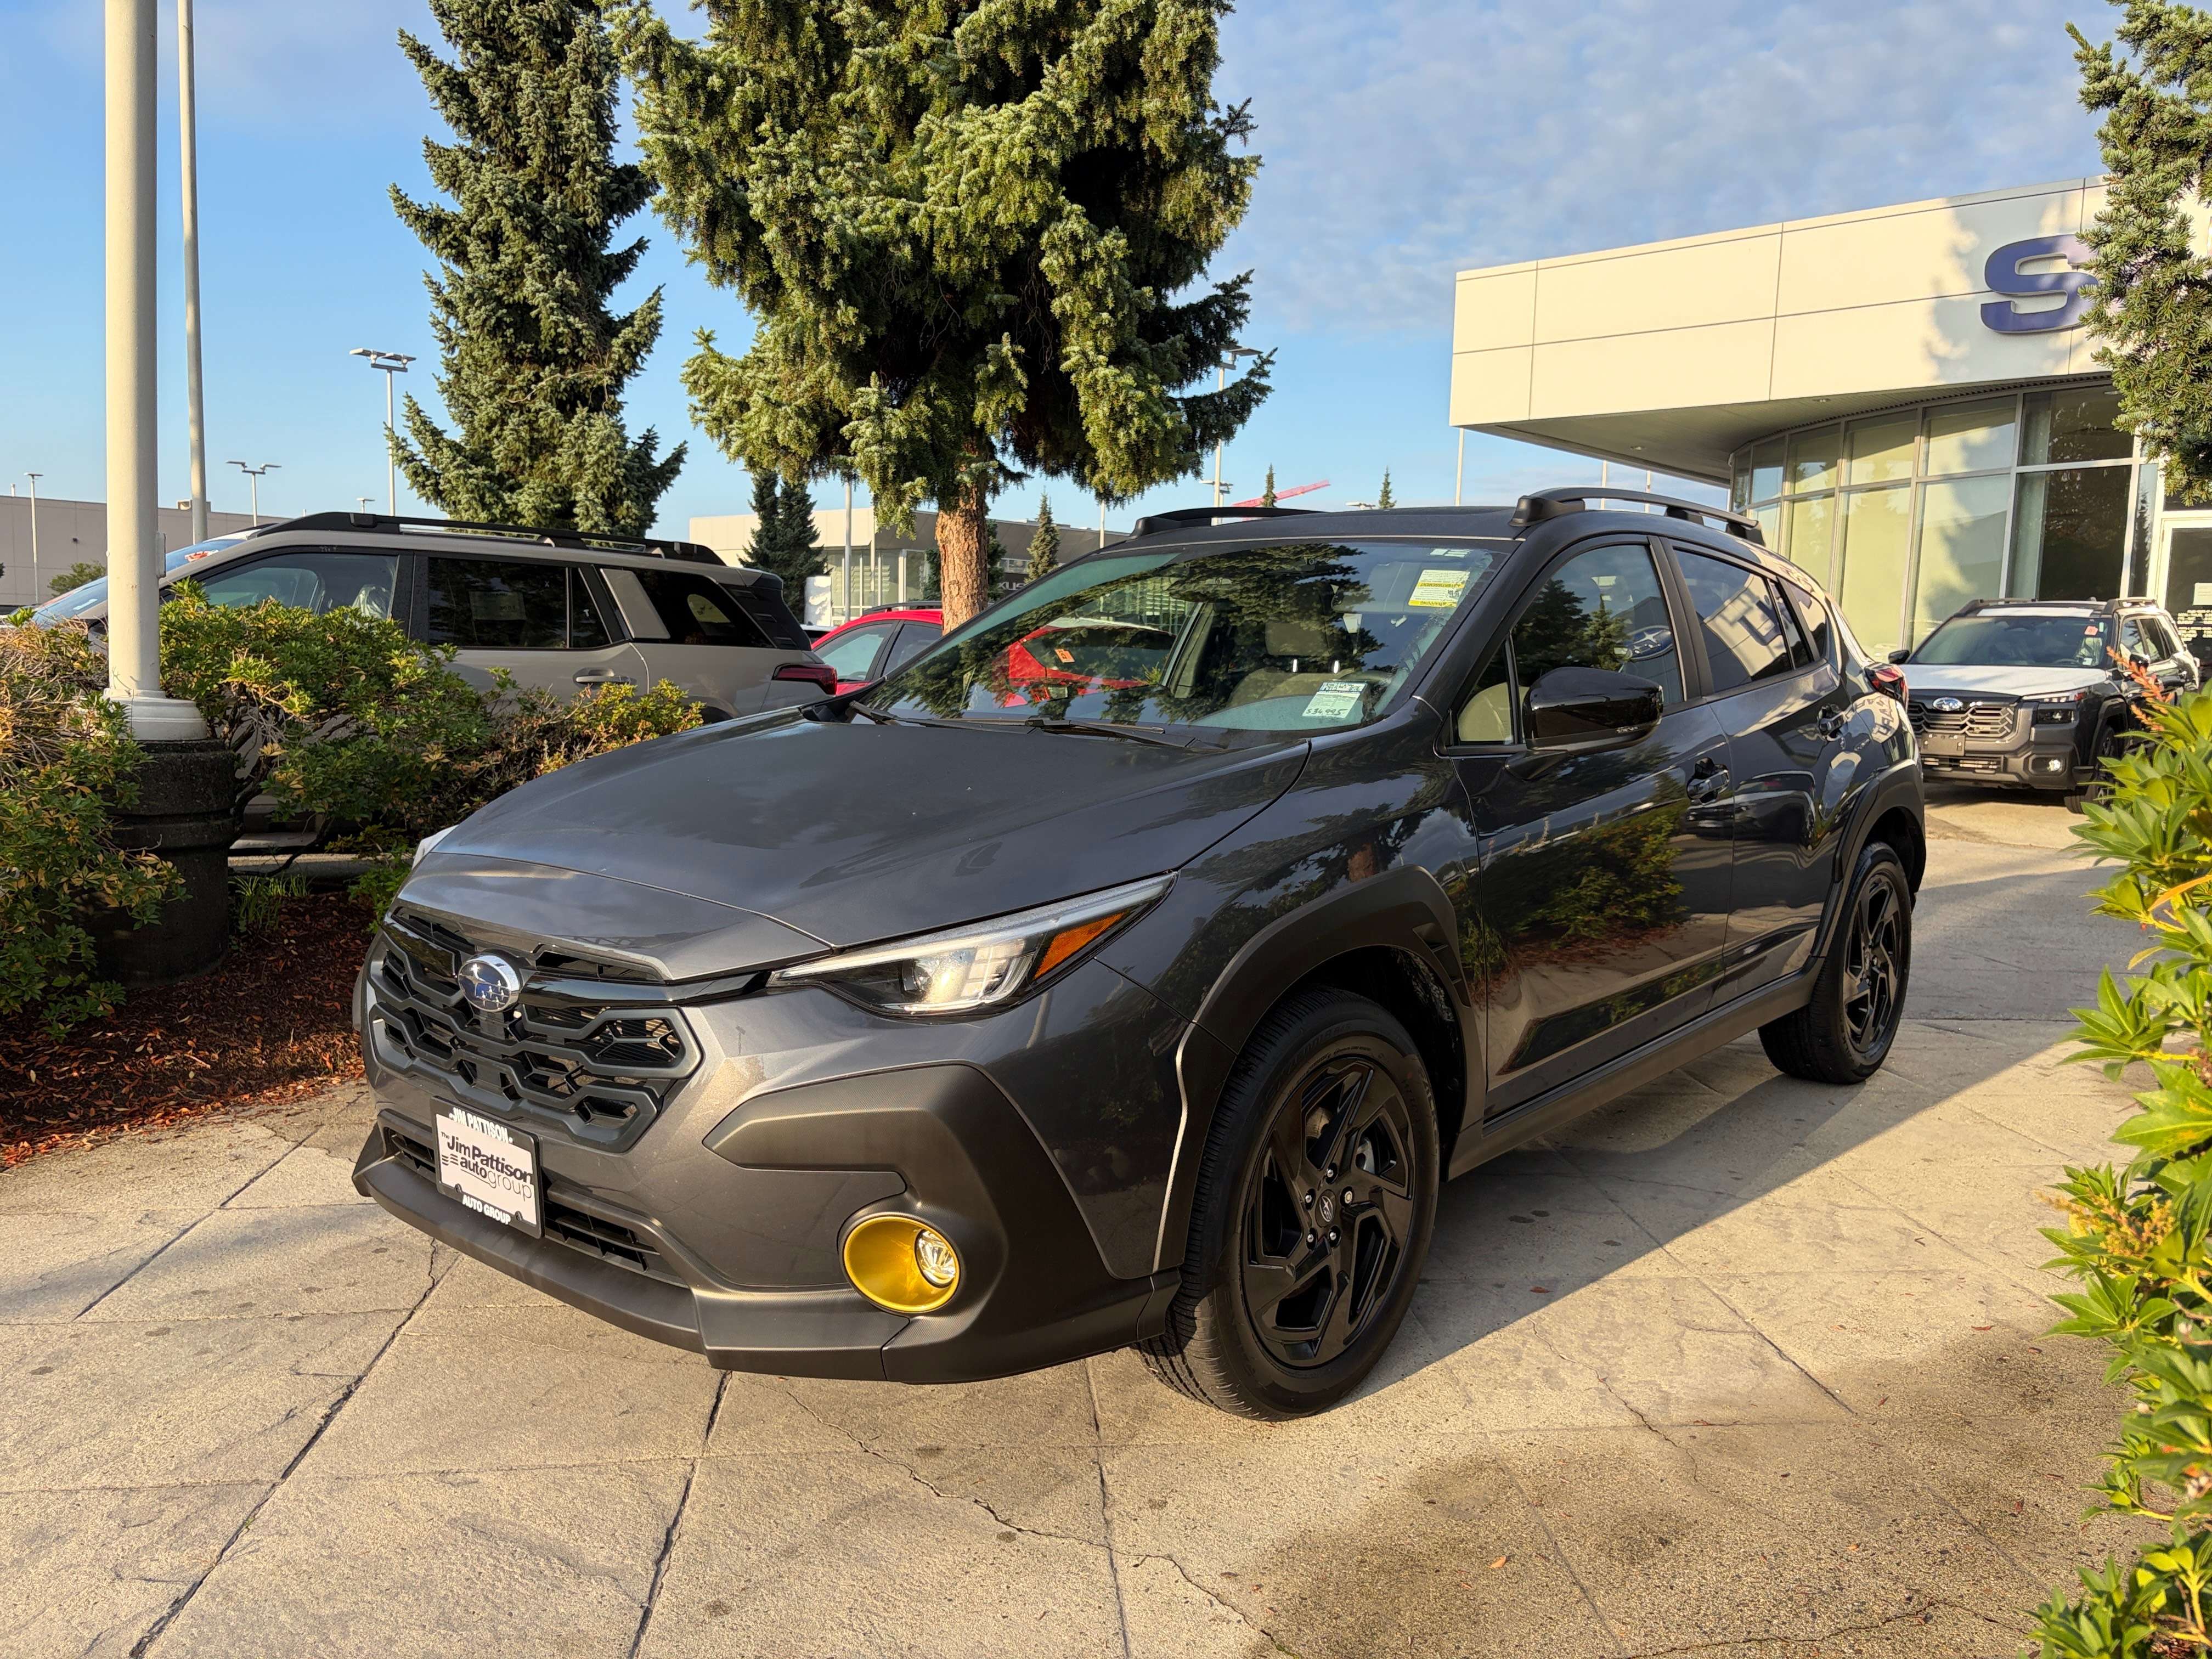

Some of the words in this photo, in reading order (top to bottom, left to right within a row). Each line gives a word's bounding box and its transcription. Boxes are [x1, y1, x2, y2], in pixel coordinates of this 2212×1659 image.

[997, 581, 1028, 591] XUS
[441, 1131, 450, 1139] The
[453, 1107, 466, 1126] JIM
[466, 1113, 509, 1143] PATTISON
[462, 1194, 483, 1213] AUTO
[483, 1204, 511, 1225] GROUP
